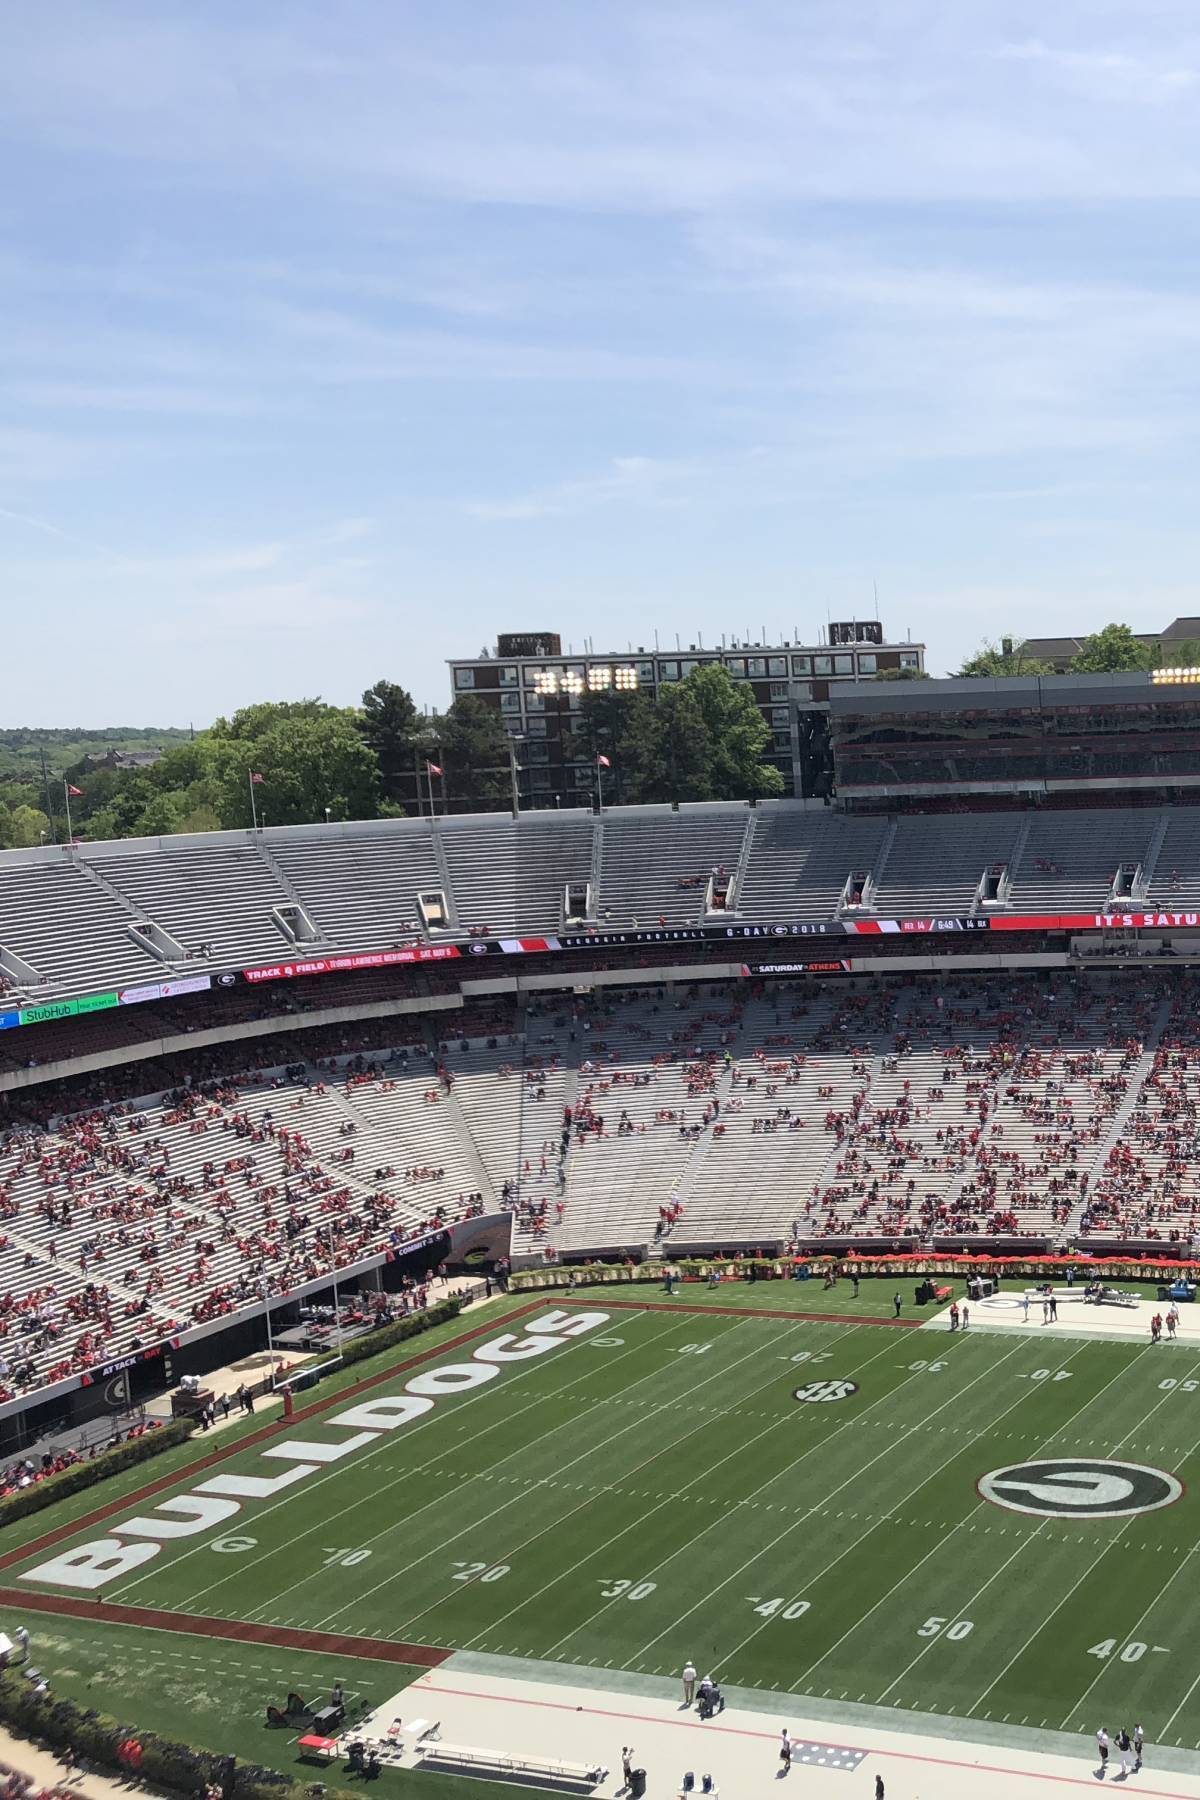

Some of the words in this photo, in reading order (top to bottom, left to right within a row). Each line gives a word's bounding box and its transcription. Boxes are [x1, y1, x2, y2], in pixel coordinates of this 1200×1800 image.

[792, 924, 826, 934] 2018
[1095, 914, 1133, 927] IT'S
[246, 967, 281, 980] TRACK
[296, 961, 325, 974] FIELD
[759, 963, 804, 973] SATURDAY
[809, 962, 841, 971] ATHENS
[26, 1005, 71, 1022] StubHub
[677, 1343, 713, 1354] 10
[789, 1351, 835, 1363] 20
[102, 1356, 137, 1377] ATTACK
[907, 1359, 949, 1372] 30
[1029, 1368, 1073, 1382] 40
[795, 1379, 856, 1402] SEC
[1157, 1377, 1200, 1393] 50
[19, 1309, 611, 1589] BULLDOGS
[323, 1548, 373, 1567] 10
[451, 1561, 512, 1583] 20
[600, 1579, 658, 1601] 30
[753, 1597, 812, 1621] 40
[916, 1616, 975, 1641] 50
[1086, 1638, 1149, 1663] 40
